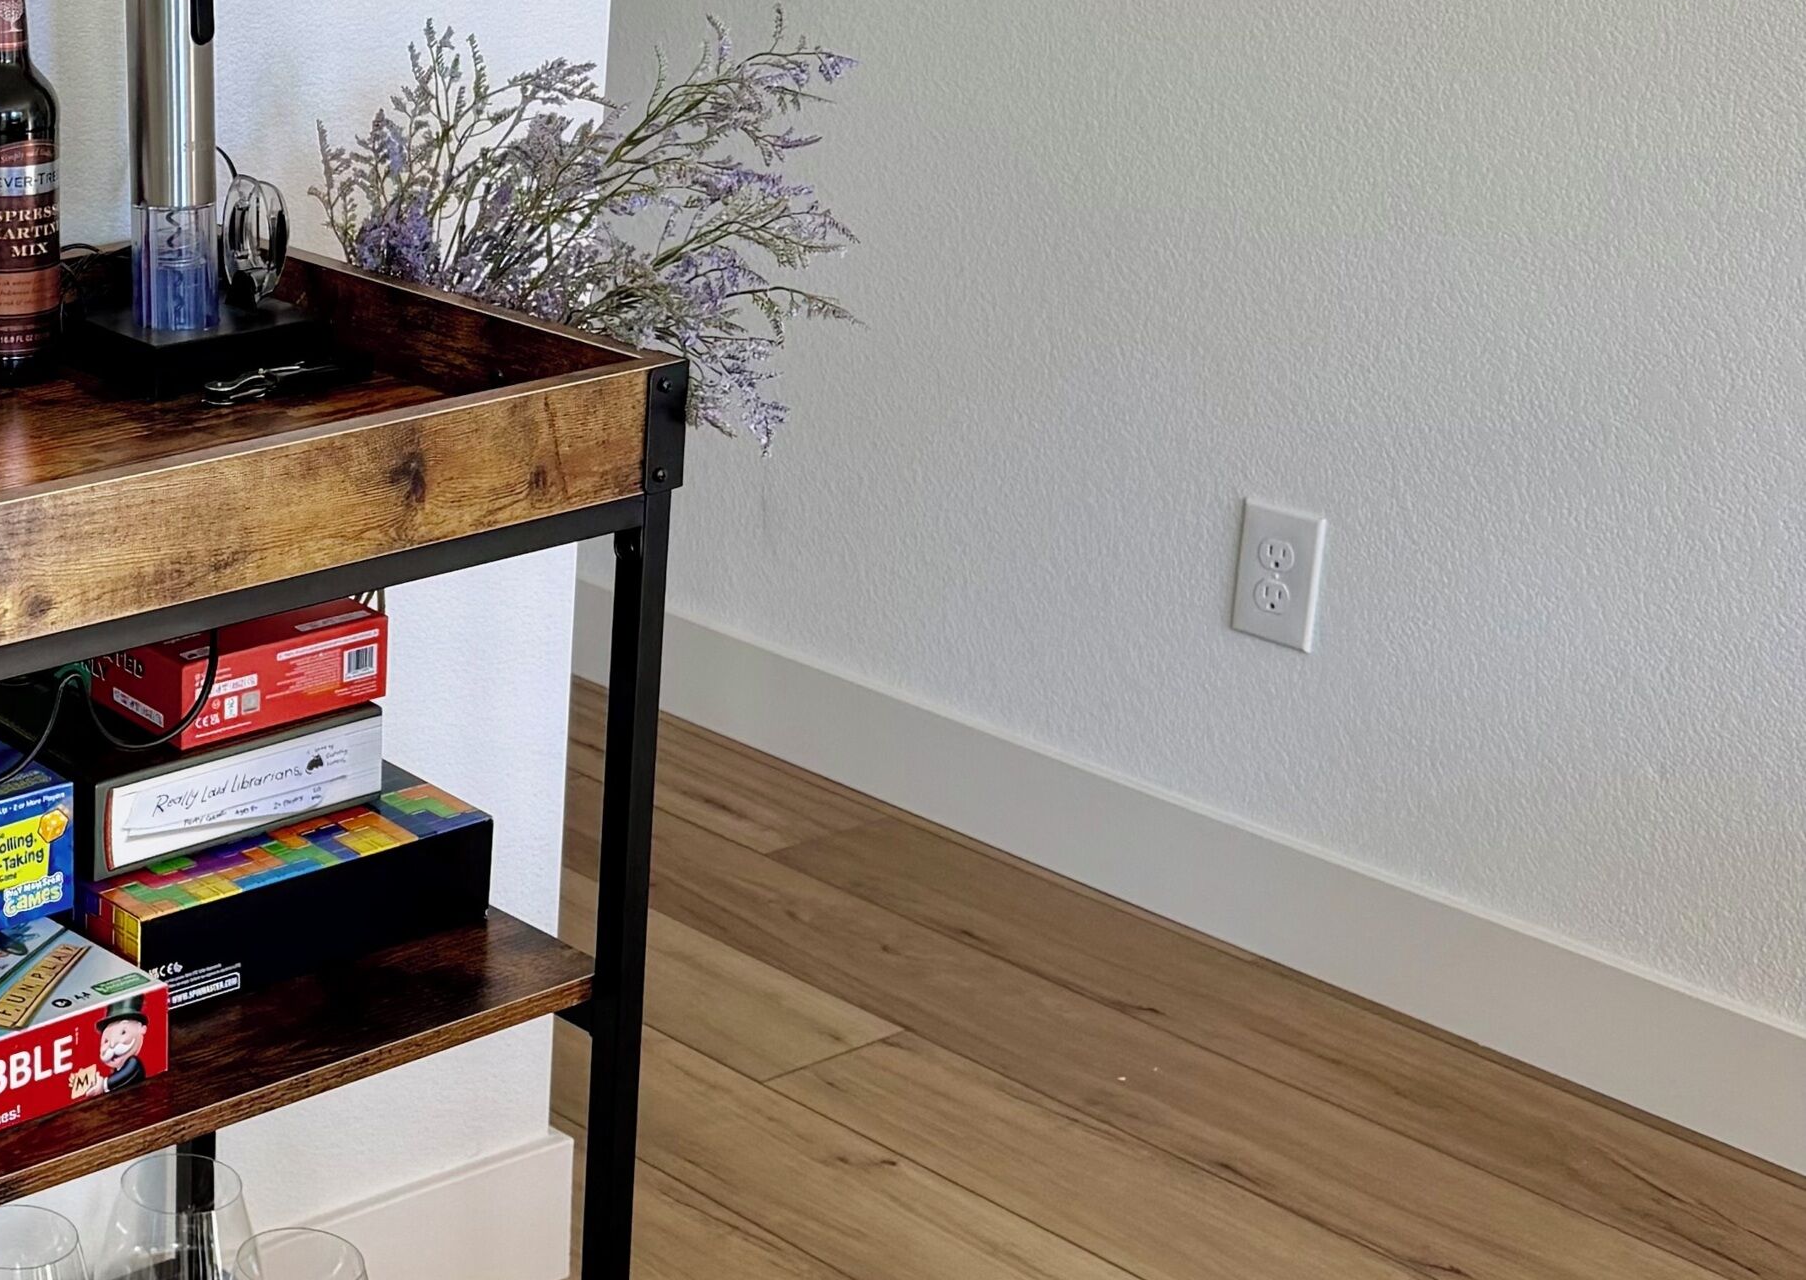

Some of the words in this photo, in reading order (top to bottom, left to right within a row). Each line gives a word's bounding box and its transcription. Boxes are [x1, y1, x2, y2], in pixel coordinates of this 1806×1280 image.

[11, 241, 48, 257] MIX
[152, 790, 199, 817] Really
[231, 765, 300, 793] Librarians
